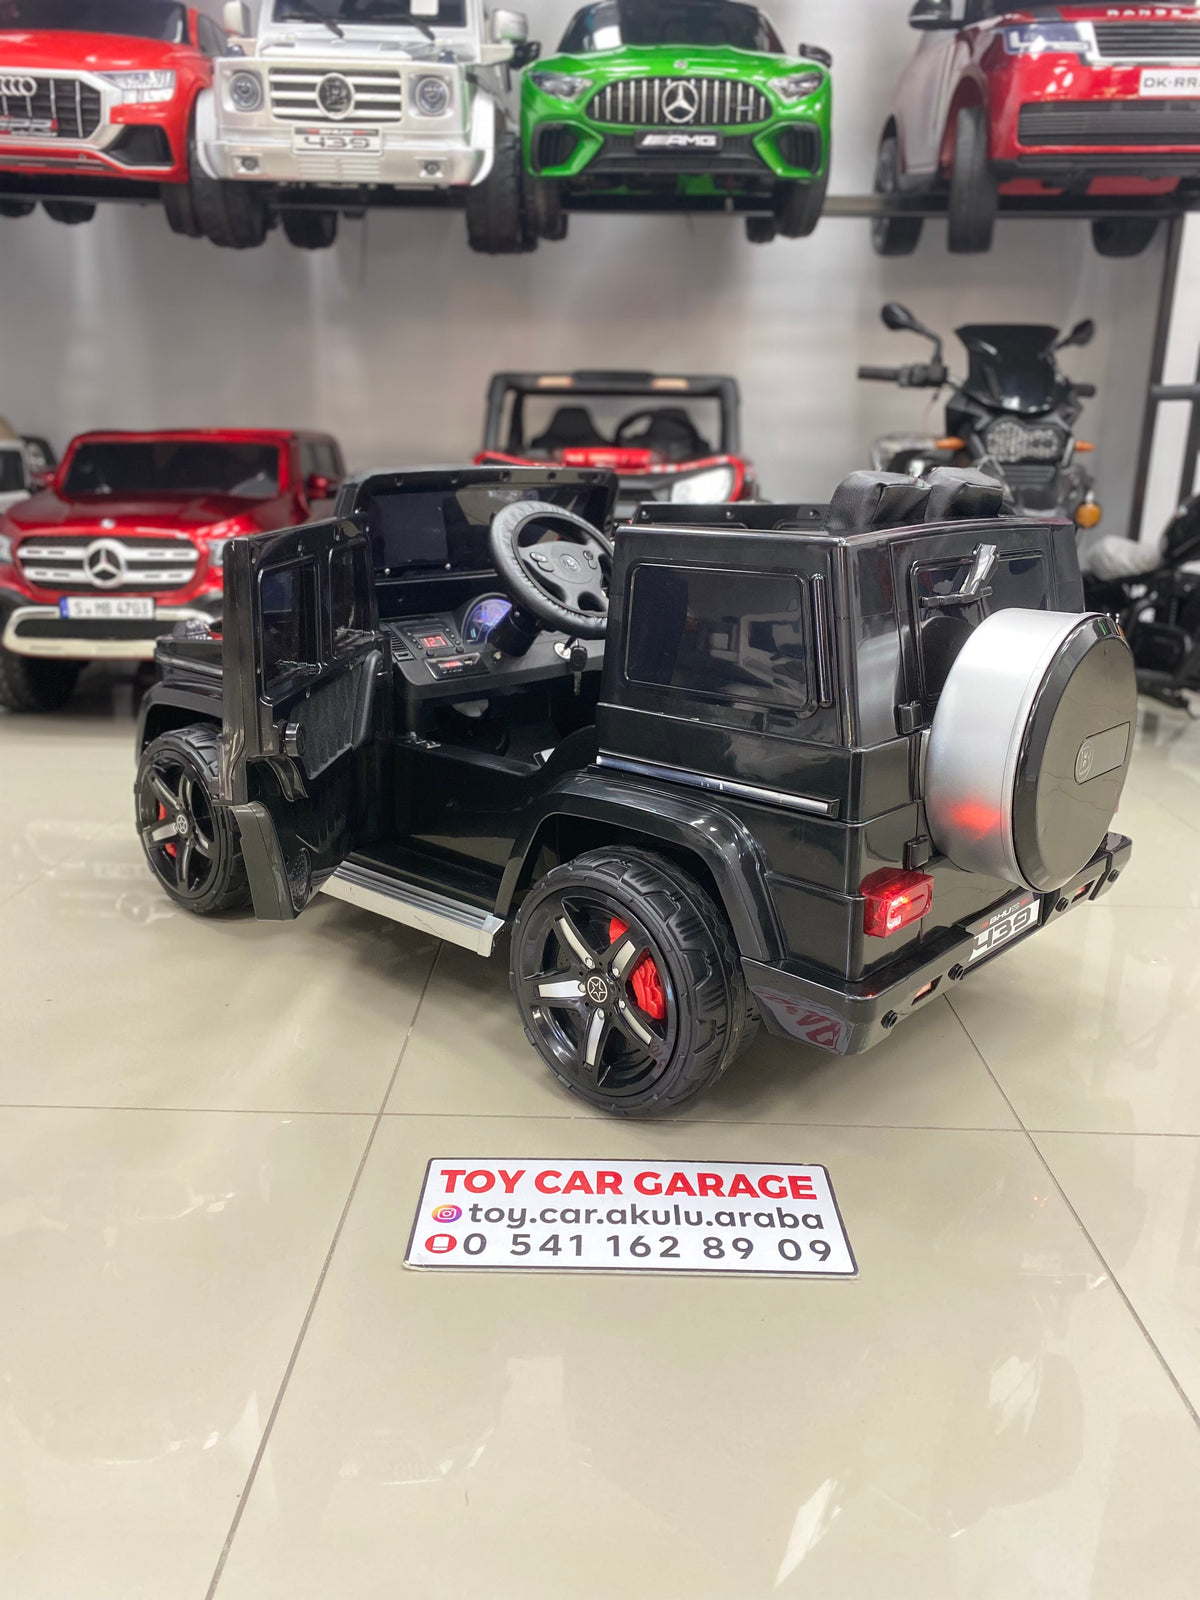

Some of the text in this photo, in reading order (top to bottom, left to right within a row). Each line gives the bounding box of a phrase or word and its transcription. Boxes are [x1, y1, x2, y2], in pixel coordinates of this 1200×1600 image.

[1143, 77, 1200, 88] DK-RR
[304, 136, 370, 149] 439
[665, 134, 717, 147] AMG
[972, 907, 1031, 950] 439
[440, 1169, 817, 1200] TOY CAR GARAGE
[468, 1203, 824, 1230] toy.car.akulu.araba
[463, 1232, 832, 1262] 0 541 162 89 09
